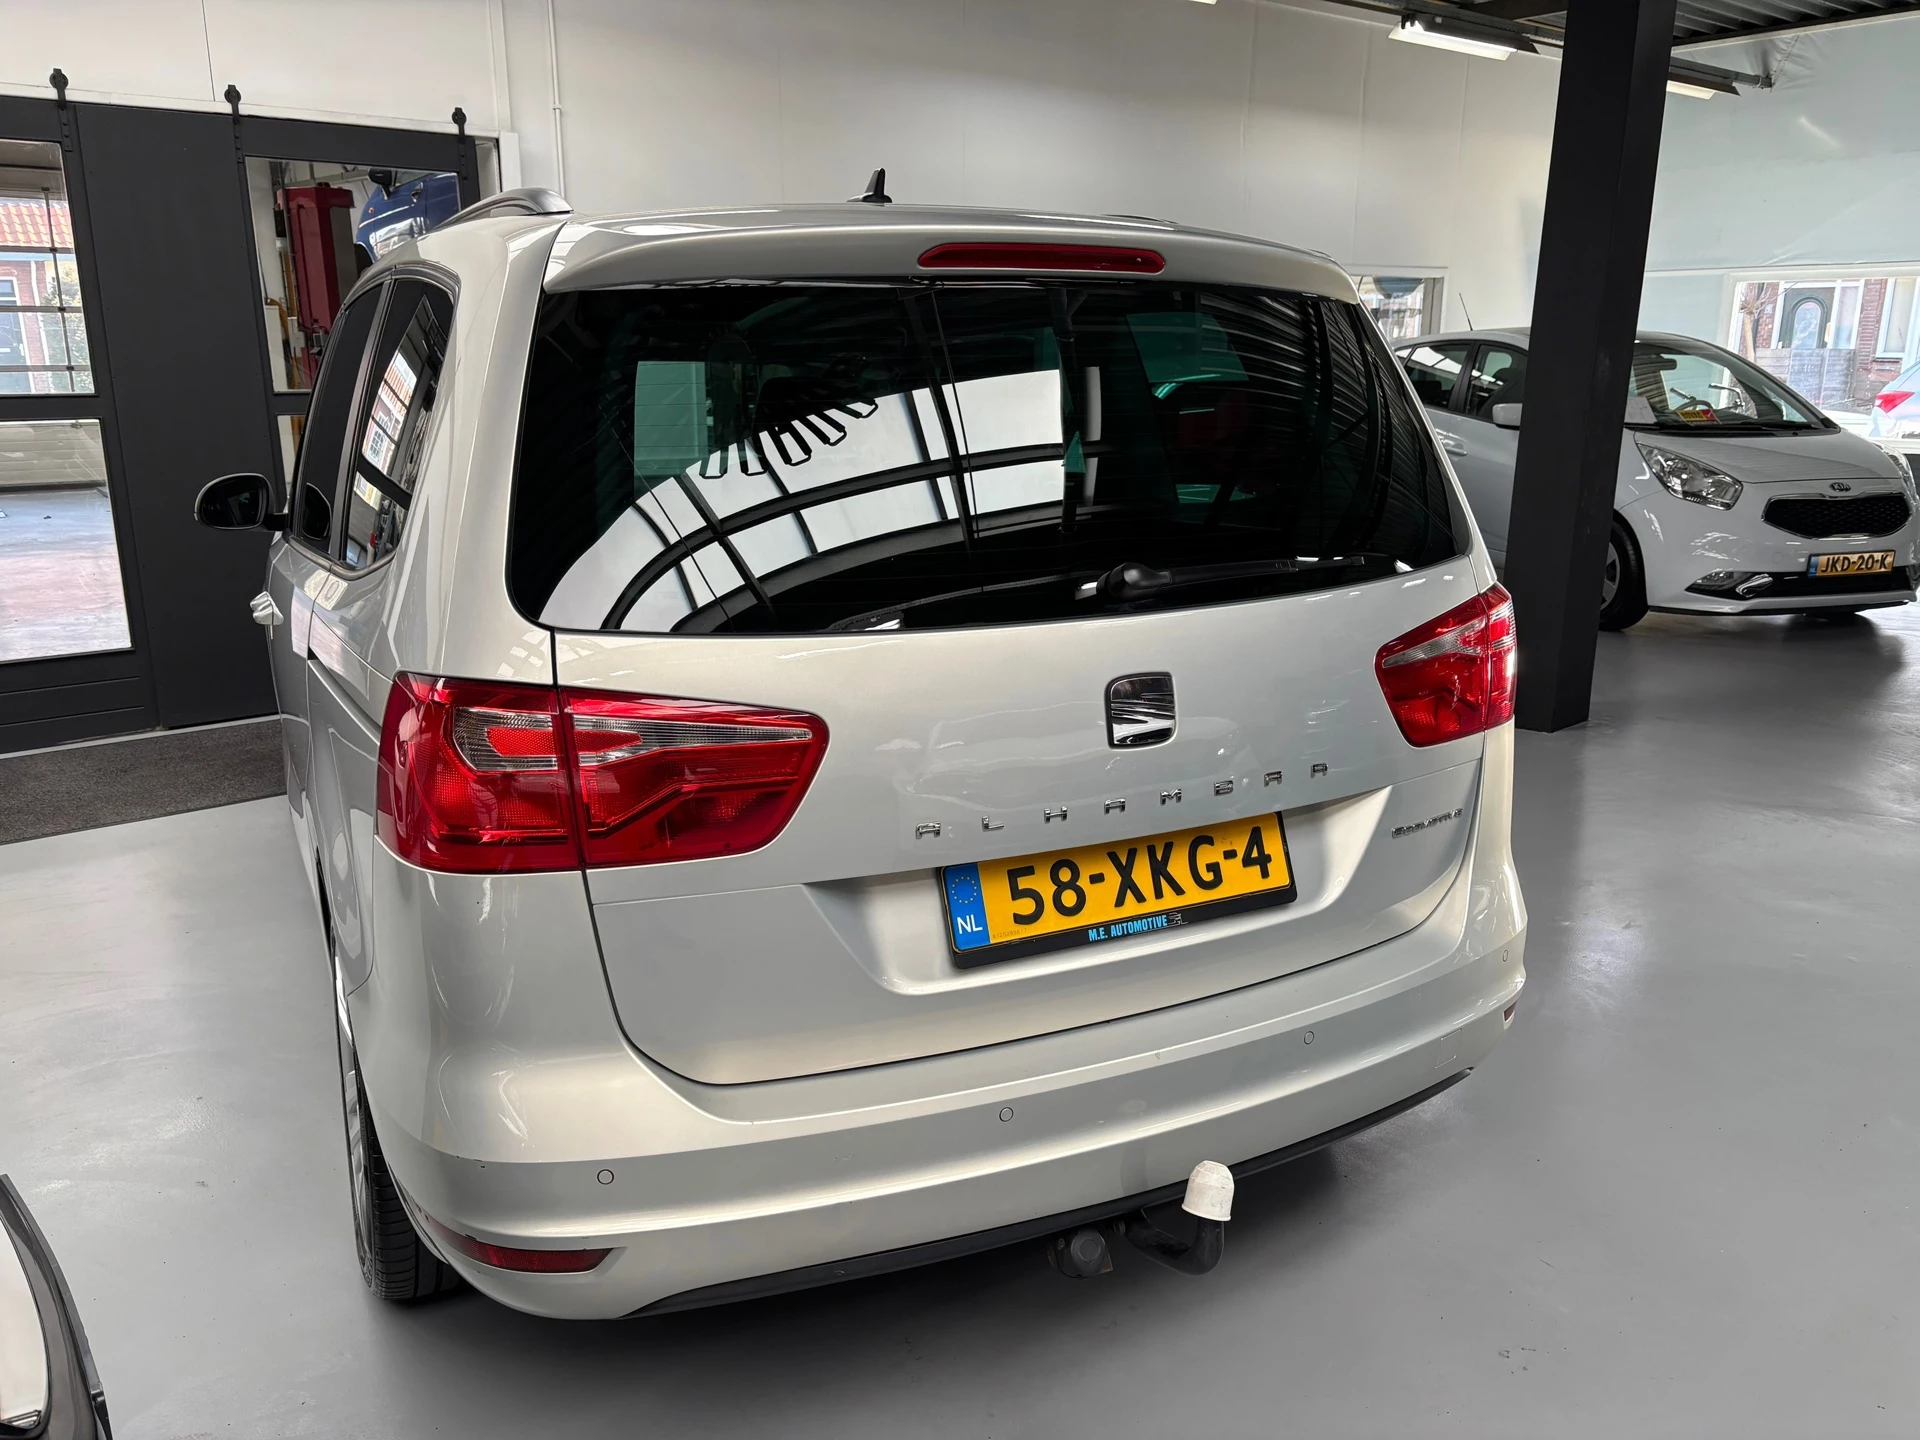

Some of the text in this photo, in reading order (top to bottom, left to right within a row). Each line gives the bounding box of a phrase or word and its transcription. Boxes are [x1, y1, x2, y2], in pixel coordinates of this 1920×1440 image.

[1831, 482, 1851, 492] KIA
[1821, 553, 1889, 573] JKD-20-K
[915, 762, 1328, 840] ALHAMBRA
[1007, 826, 1272, 926] 58-XKG-4
[956, 914, 983, 935] NL
[1088, 914, 1168, 942] M.E. AUTOMOTIVE
